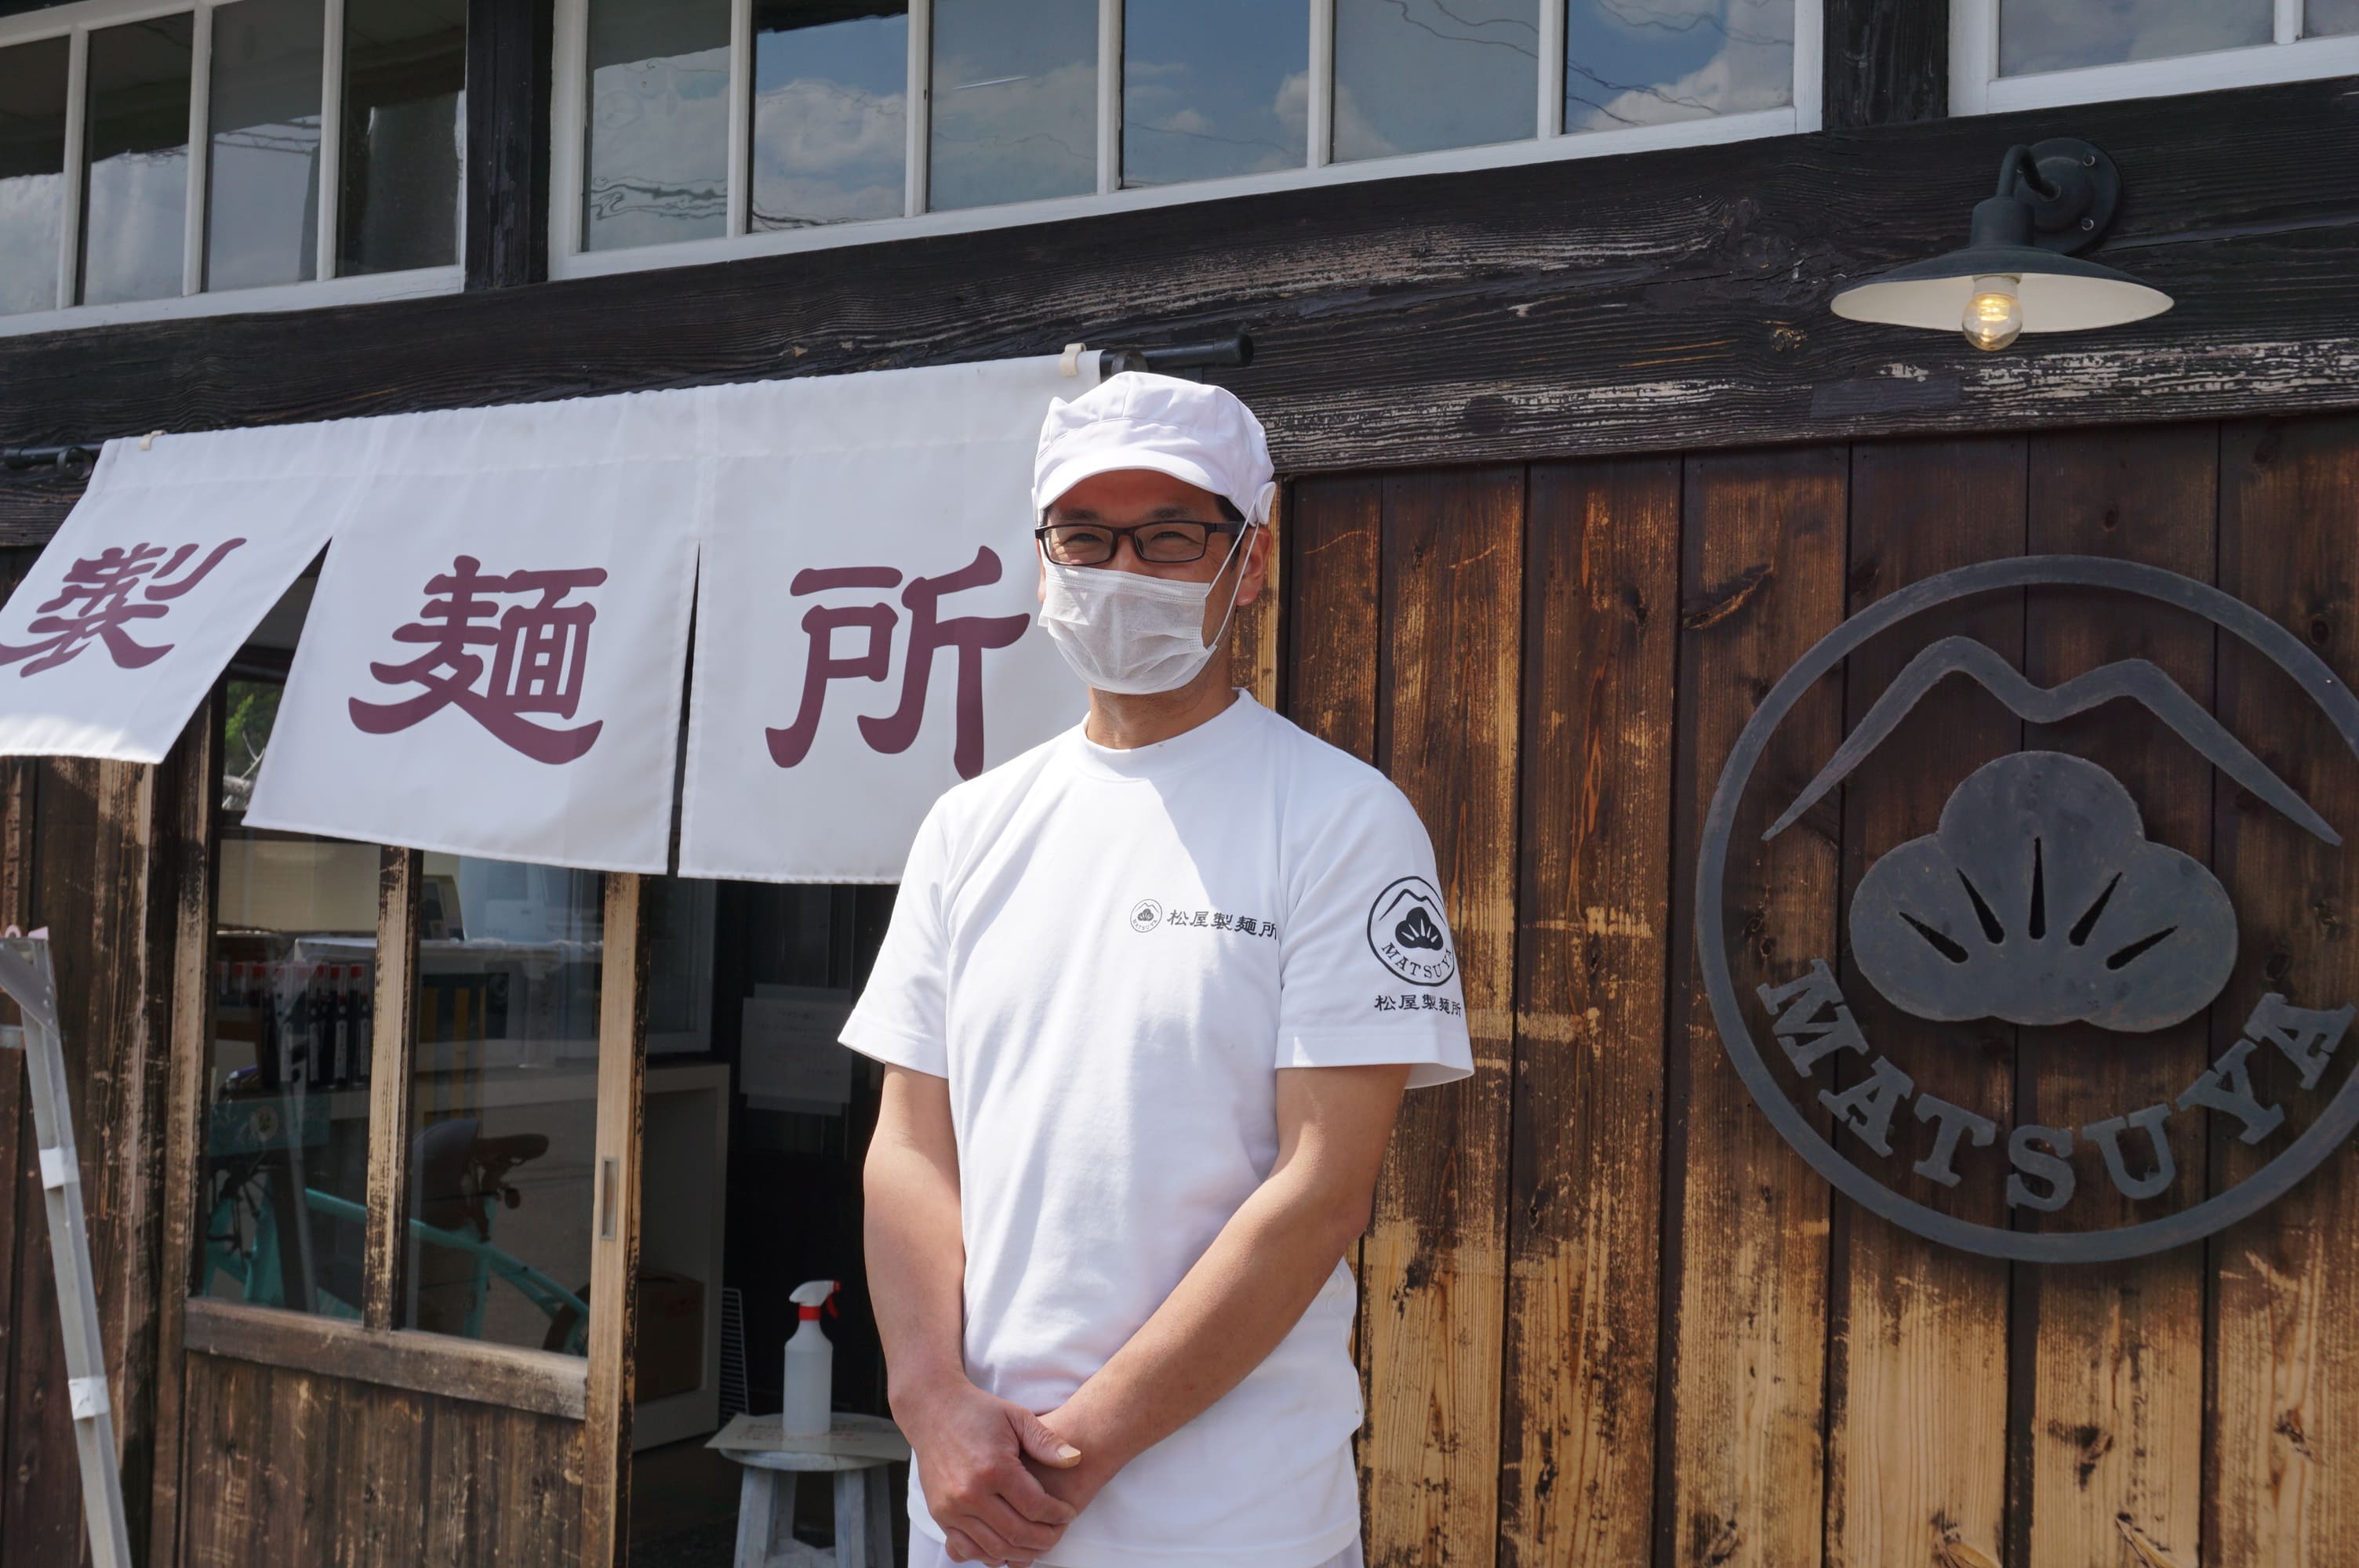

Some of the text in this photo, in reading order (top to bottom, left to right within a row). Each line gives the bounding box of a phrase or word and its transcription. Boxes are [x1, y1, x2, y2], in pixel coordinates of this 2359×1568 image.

[0, 538, 1030, 780] 製麺所
[1132, 919, 1158, 931] MATSUYA
[1166, 909, 1277, 940] 松屋製麺所
[1374, 993, 1462, 1018] 松屋製麺所
[1756, 958, 2354, 1213] MATSUYA
